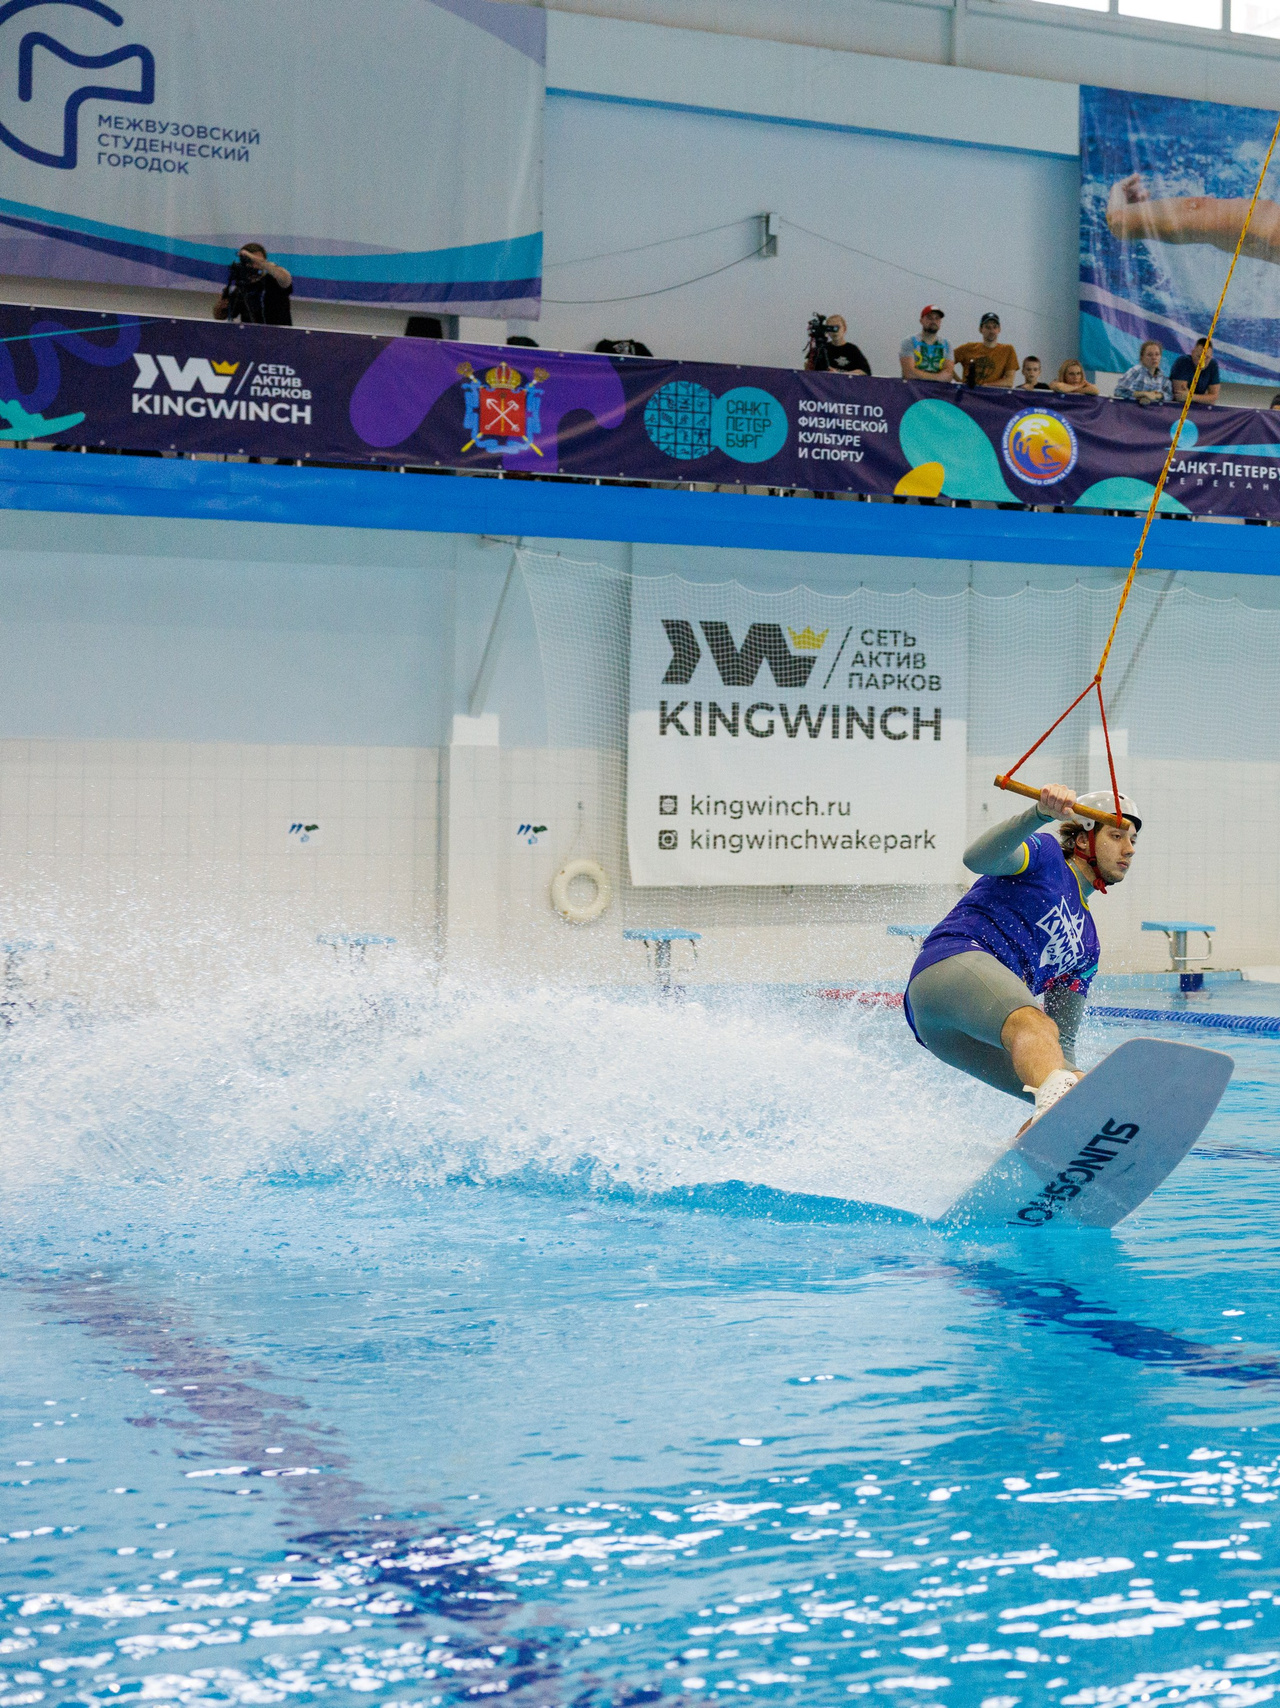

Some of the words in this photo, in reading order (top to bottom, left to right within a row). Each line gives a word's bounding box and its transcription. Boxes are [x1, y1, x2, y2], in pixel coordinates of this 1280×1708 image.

[98, 114, 260, 145] МЕЖВУЗОВСКИЙ
[97, 133, 250, 163] СТУДЕНЧЕСКИЙ
[97, 152, 189, 175] ГОРОДОК
[258, 363, 296, 376] СЕТЬ
[252, 375, 302, 388] АКТИВ
[250, 386, 312, 400] ПАРКОВ
[132, 393, 312, 425] KINGWINCH
[726, 400, 771, 416] САНКТ
[798, 400, 860, 416] КОМИТЕТ
[863, 405, 883, 418] ПО
[726, 416, 772, 433] ПЕТЕР
[798, 416, 888, 433] ФИЗИЧЕСКОЙ
[726, 432, 763, 449] БУРГ
[798, 432, 861, 447] КУЛЬТУРЕ
[798, 448, 808, 459] И
[811, 448, 864, 463] СПОРТУ
[860, 629, 917, 648] СЕТЬ
[850, 651, 926, 670] АКТИВ
[848, 672, 942, 692] ПАРКОВ
[658, 700, 942, 741] KINGWINCH
[690, 794, 851, 820] kingwinch.ru
[690, 829, 937, 854] kingwinchwakepark
